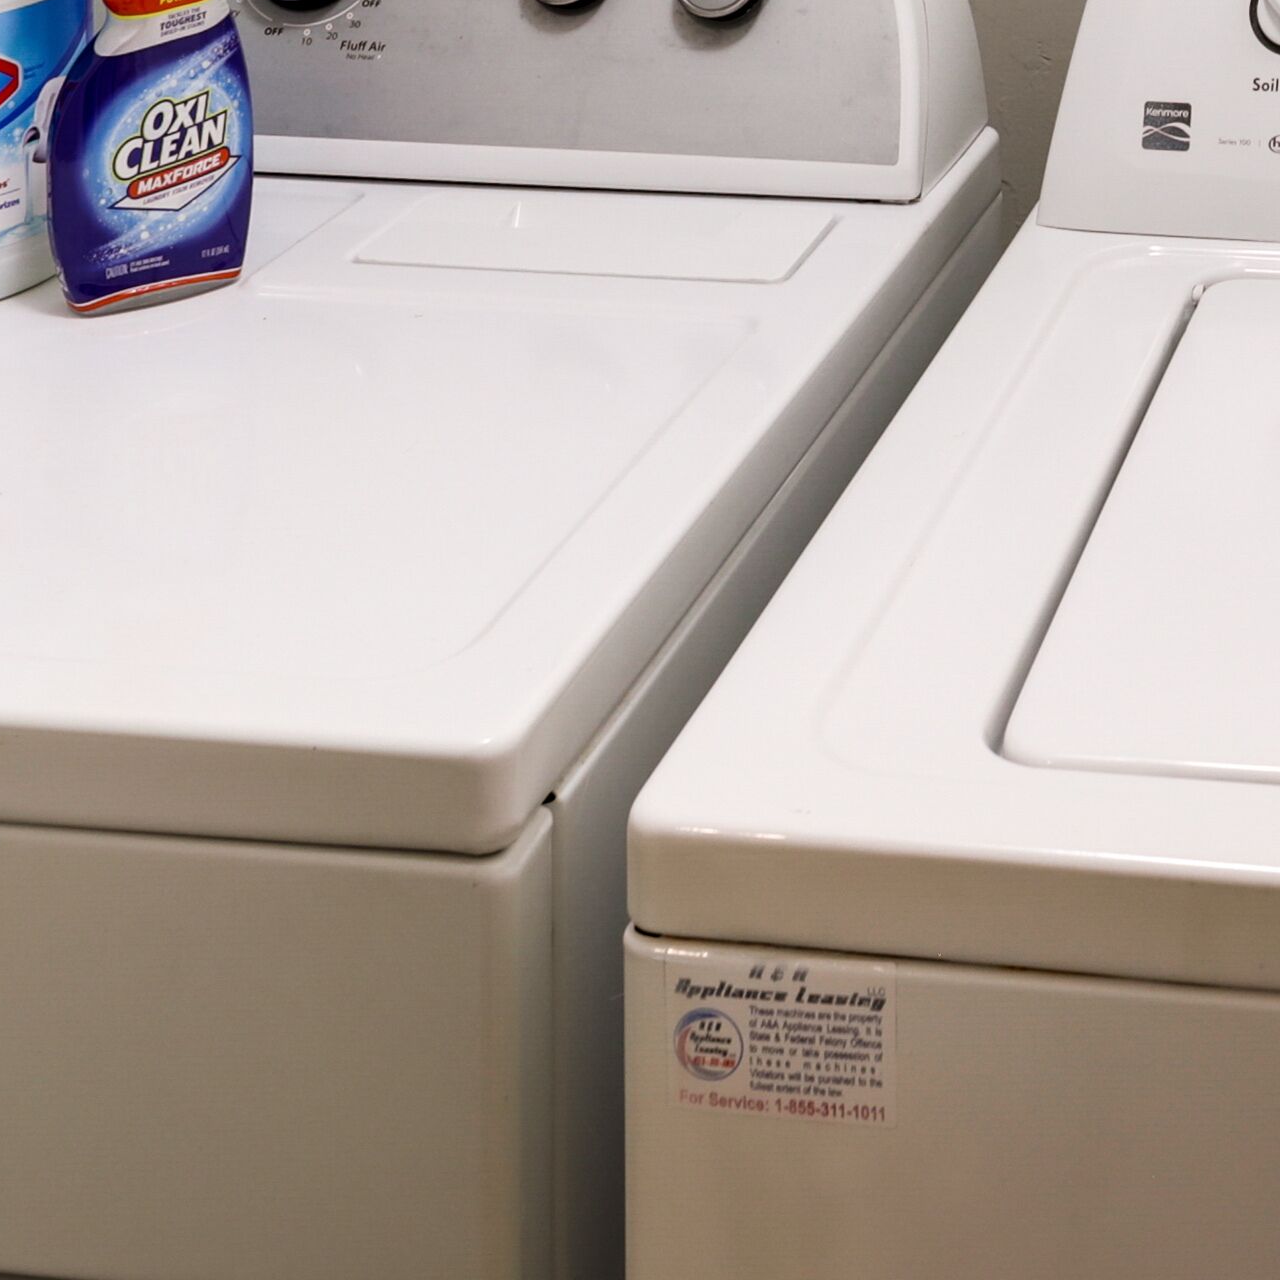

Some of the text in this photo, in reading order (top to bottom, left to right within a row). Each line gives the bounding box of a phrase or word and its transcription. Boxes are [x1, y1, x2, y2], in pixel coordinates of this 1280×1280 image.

[362, 0, 381, 8] OFF
[161, 11, 207, 30] TOUGHEST
[349, 20, 361, 28] 30
[264, 27, 283, 35] OFF
[326, 32, 338, 40] 20
[302, 37, 312, 45] 10
[340, 40, 386, 52] Fluff Air
[1252, 77, 1280, 93] Soil
[143, 94, 208, 140] OXI
[1146, 106, 1189, 119] Kenmore
[114, 112, 226, 180] CLEAN
[137, 152, 221, 195] MAXFORCE
[675, 977, 887, 1012] Appliance Leasing
[749, 1005, 882, 1025] These machines are the property
[782, 1021, 822, 1033] Appliance
[749, 1030, 770, 1041] State
[819, 1036, 847, 1049] Felony
[762, 1046, 784, 1055] move
[750, 1068, 882, 1088] Violators will punished the
[813, 1087, 826, 1096] the
[679, 1088, 886, 1122] For Service: 1-855-311-1011
